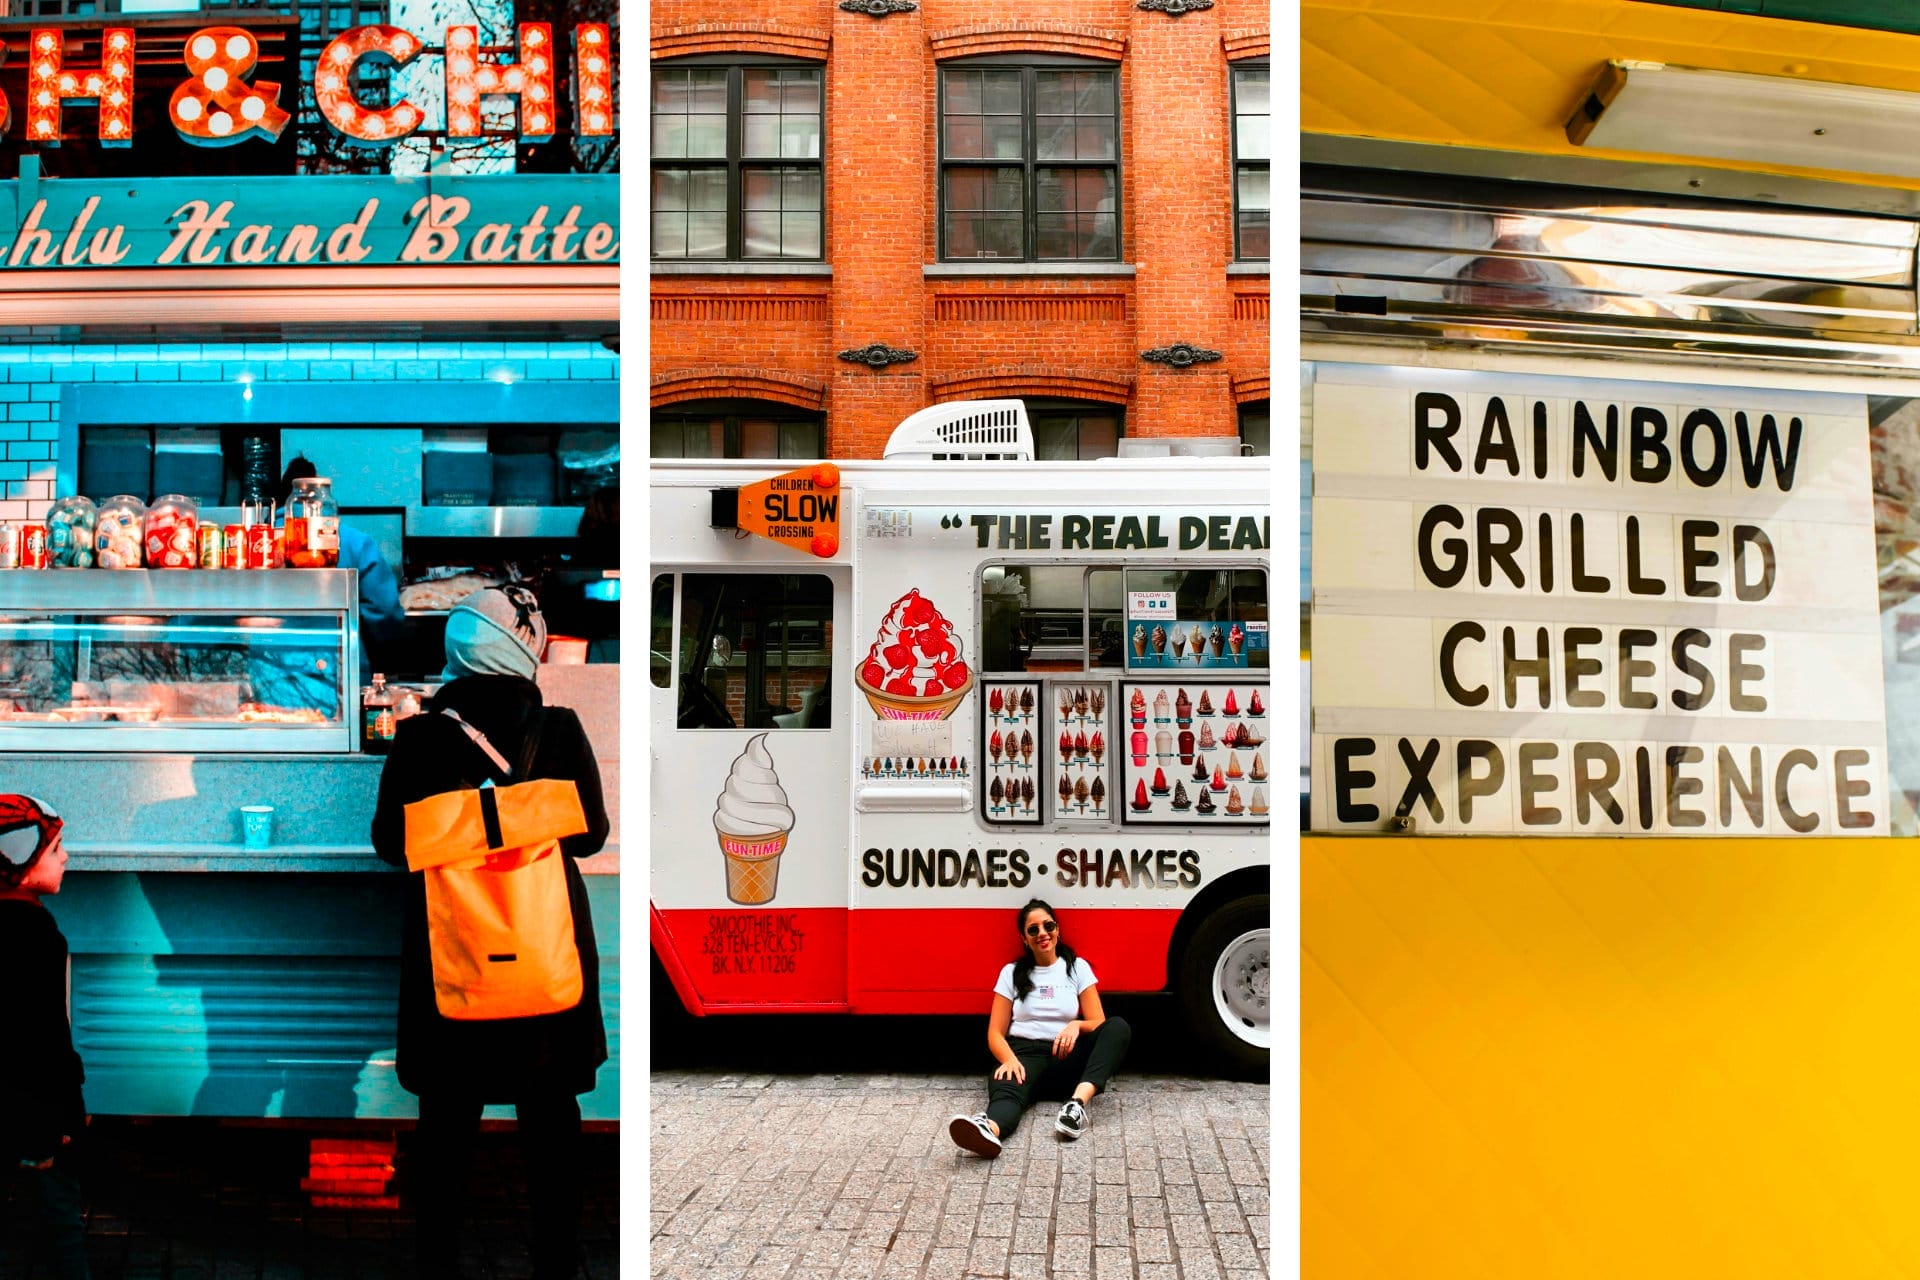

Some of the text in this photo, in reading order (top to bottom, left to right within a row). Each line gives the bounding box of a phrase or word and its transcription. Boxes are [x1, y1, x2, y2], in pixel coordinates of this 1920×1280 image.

[0, 22, 614, 147] H & CHI
[157, 198, 379, 264] Hand
[1414, 392, 1803, 492] RAINBOW
[770, 478, 814, 491] CHILDREN
[764, 493, 838, 523] SLOW
[768, 525, 814, 538] CROSSING
[1062, 514, 1168, 550] REAL
[1417, 504, 1777, 602] GRILLED
[1439, 620, 1768, 713] CHEESE
[1333, 737, 1876, 833] EXPERIENCE
[725, 840, 781, 857] FUN-TIME
[862, 848, 1202, 889] SUNDAES SHAKES
[708, 914, 773, 935] SMOOTHIE
[703, 935, 724, 955] 328
[759, 954, 796, 974] 11206
